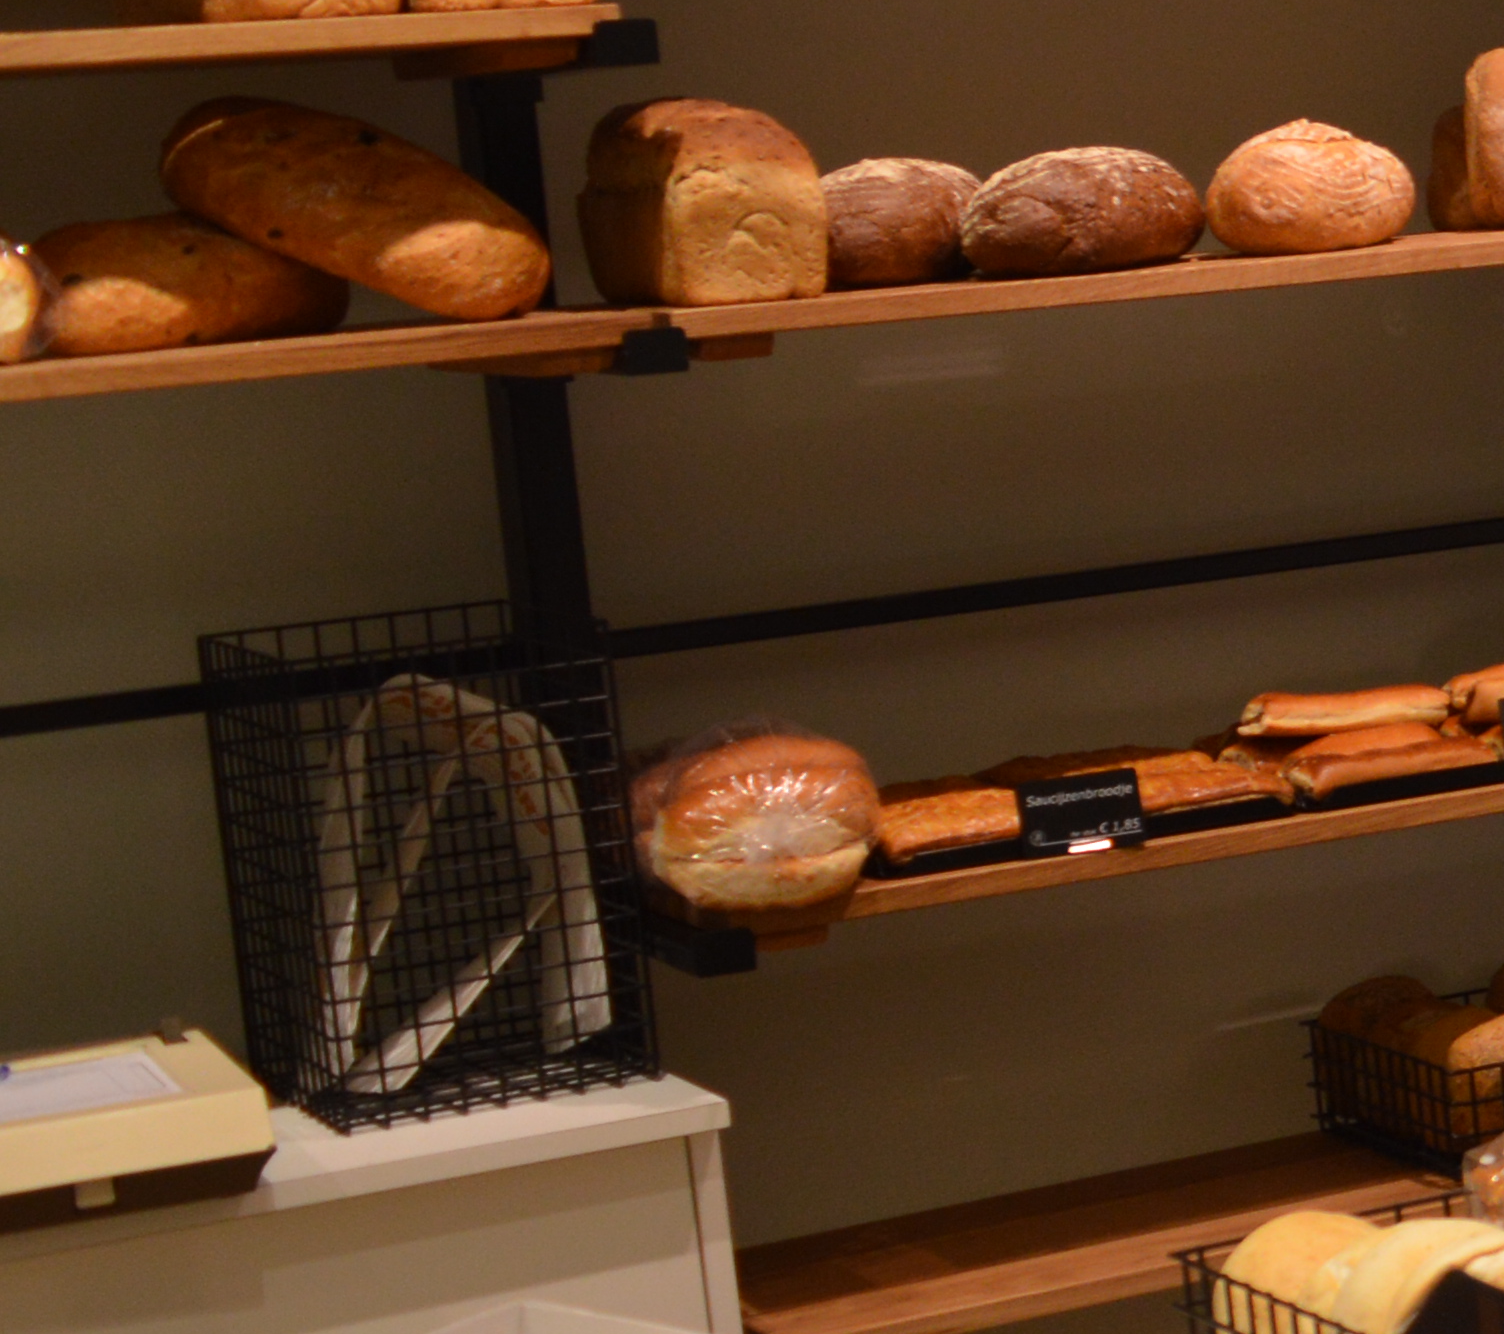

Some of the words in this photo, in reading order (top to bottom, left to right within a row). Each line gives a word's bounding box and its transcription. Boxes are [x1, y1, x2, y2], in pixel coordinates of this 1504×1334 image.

[1026, 784, 1133, 807] Saucijzenbroodje
[1099, 821, 1108, 833] €
[1112, 817, 1140, 831] 1,85
